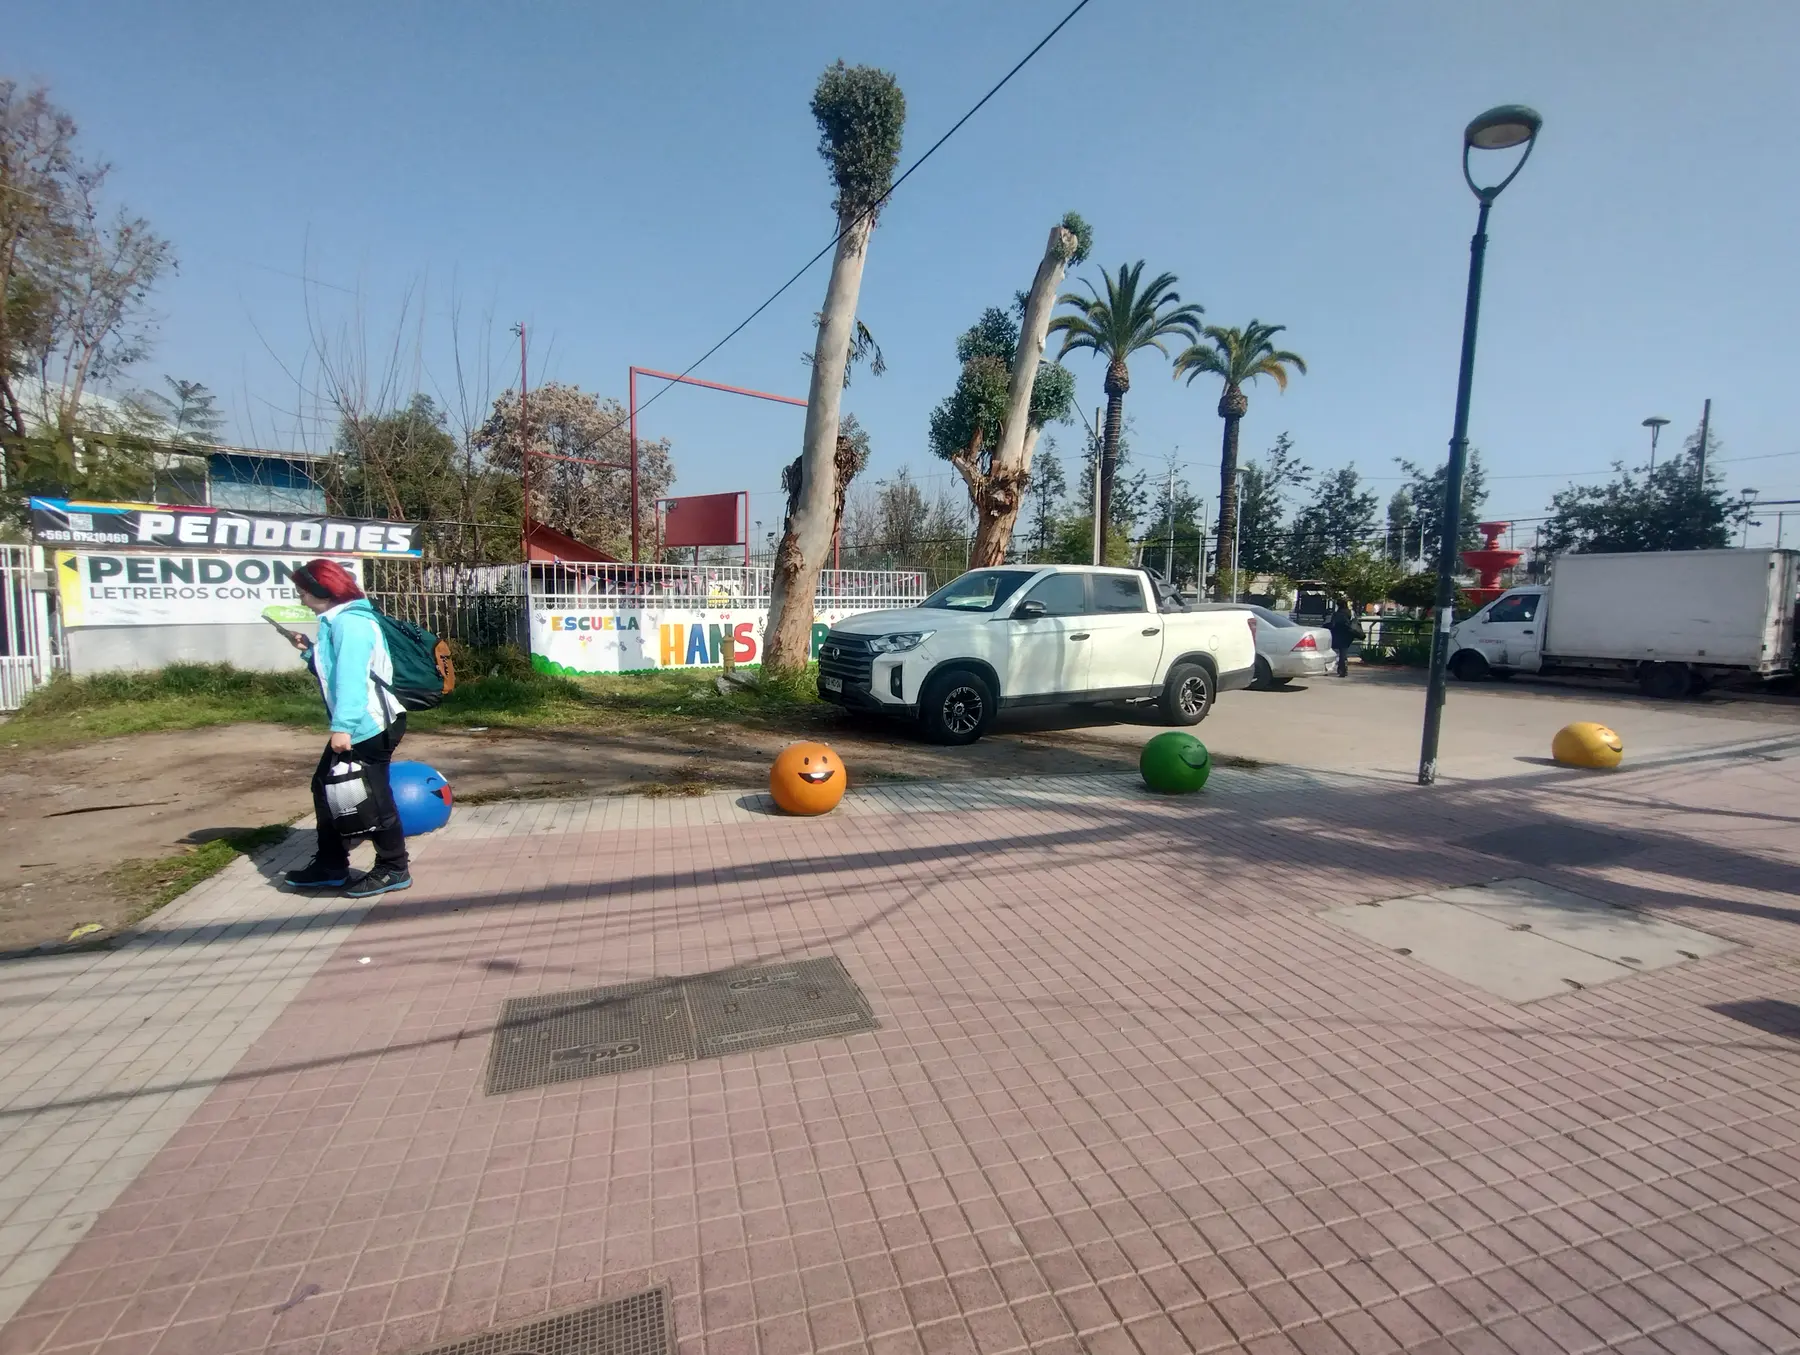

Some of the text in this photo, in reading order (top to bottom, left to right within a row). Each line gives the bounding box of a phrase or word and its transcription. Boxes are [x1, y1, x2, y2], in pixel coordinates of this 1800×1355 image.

[38, 530, 70, 541] +569
[137, 513, 412, 552] PENDONES
[88, 556, 357, 585] PENDON
[90, 586, 299, 600] LETREROS CON TEL
[551, 616, 640, 631] ESCUELA
[660, 622, 757, 666] HANS
